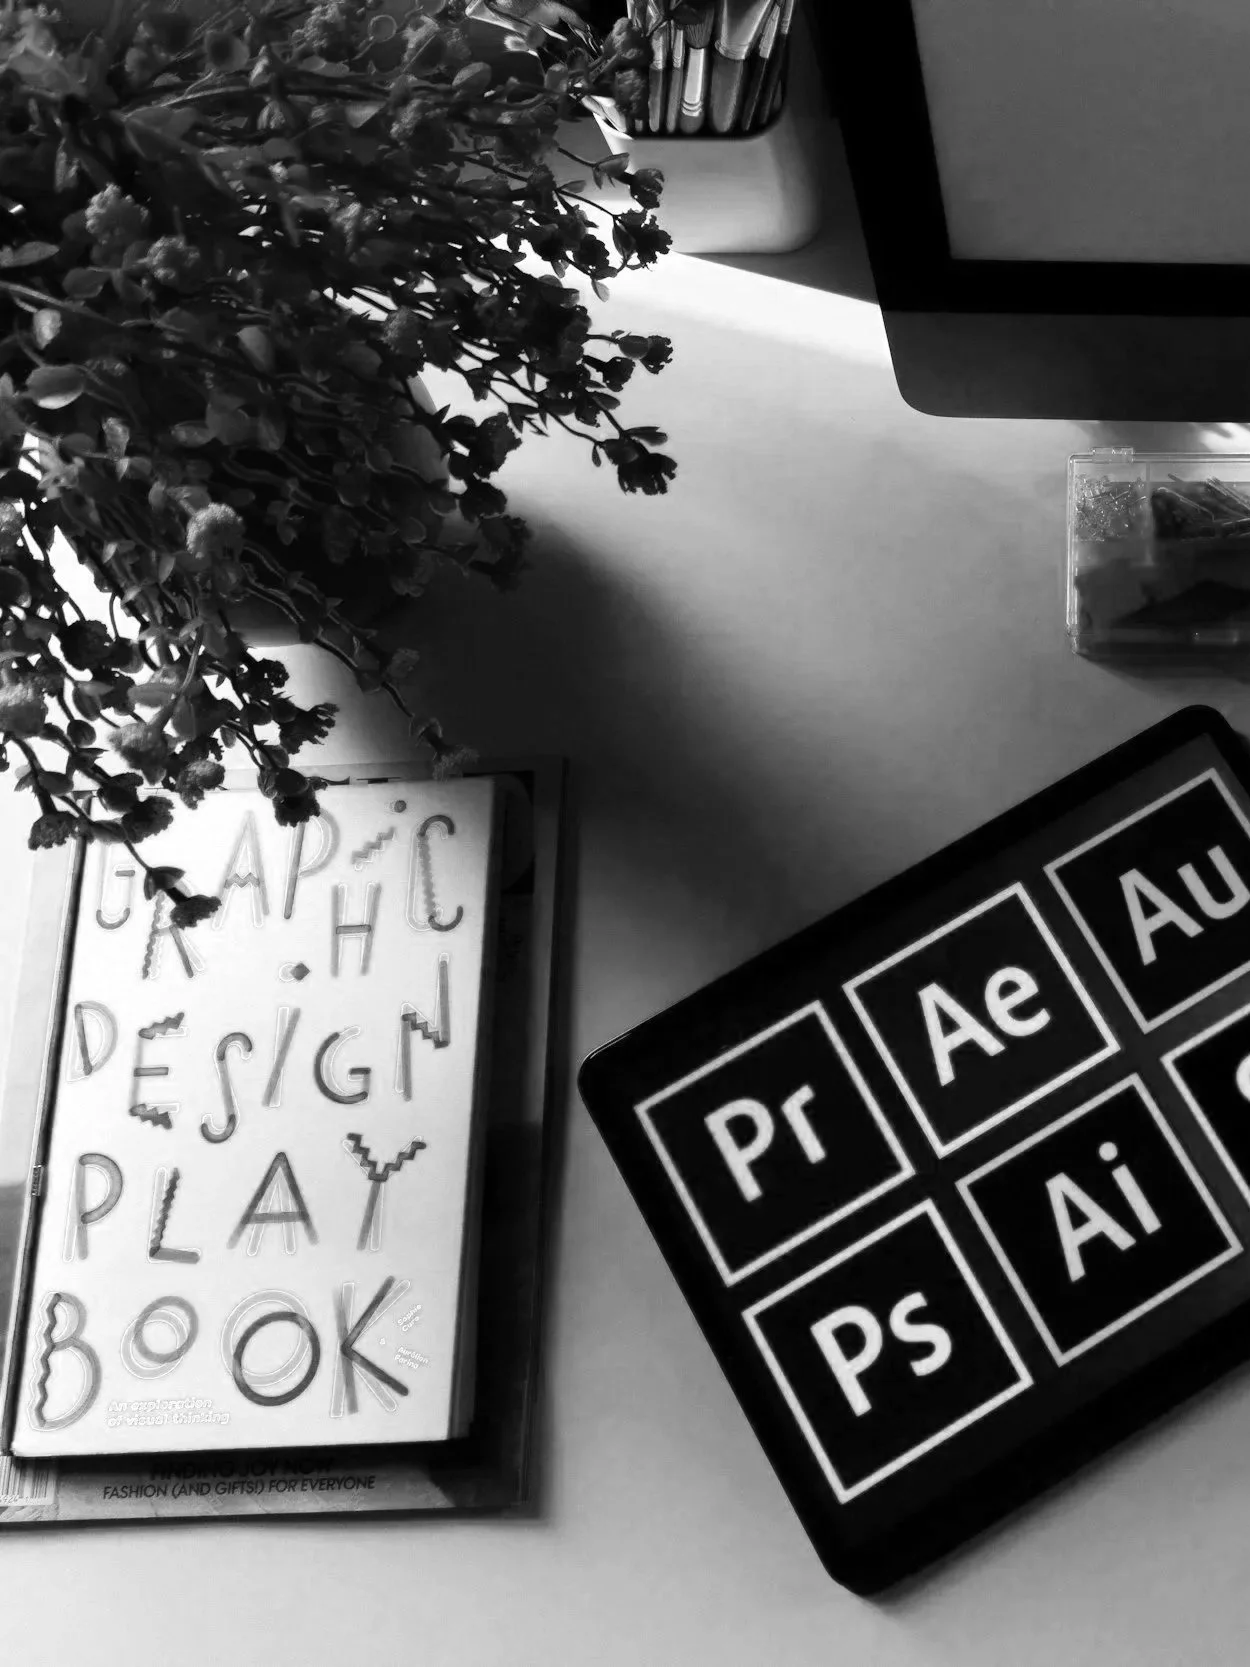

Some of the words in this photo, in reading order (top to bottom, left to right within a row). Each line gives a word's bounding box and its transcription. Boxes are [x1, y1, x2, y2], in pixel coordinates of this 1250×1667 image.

[65, 952, 452, 1144] DESIGN
[918, 963, 1051, 1087] Ae
[62, 1133, 427, 1264] PLAY
[705, 1083, 827, 1203] Pr
[1045, 1140, 1163, 1283] Ai
[28, 1276, 412, 1432] BOOK
[130, 1396, 213, 1412] exploration
[809, 1291, 953, 1418] Ps
[172, 1410, 230, 1425] thinking
[103, 1485, 169, 1500] FASHION
[171, 1482, 210, 1499] (AND
[215, 1479, 264, 1495] GIFTS!)
[268, 1478, 297, 1493] FOR
[301, 1475, 376, 1492] EVERYONE
